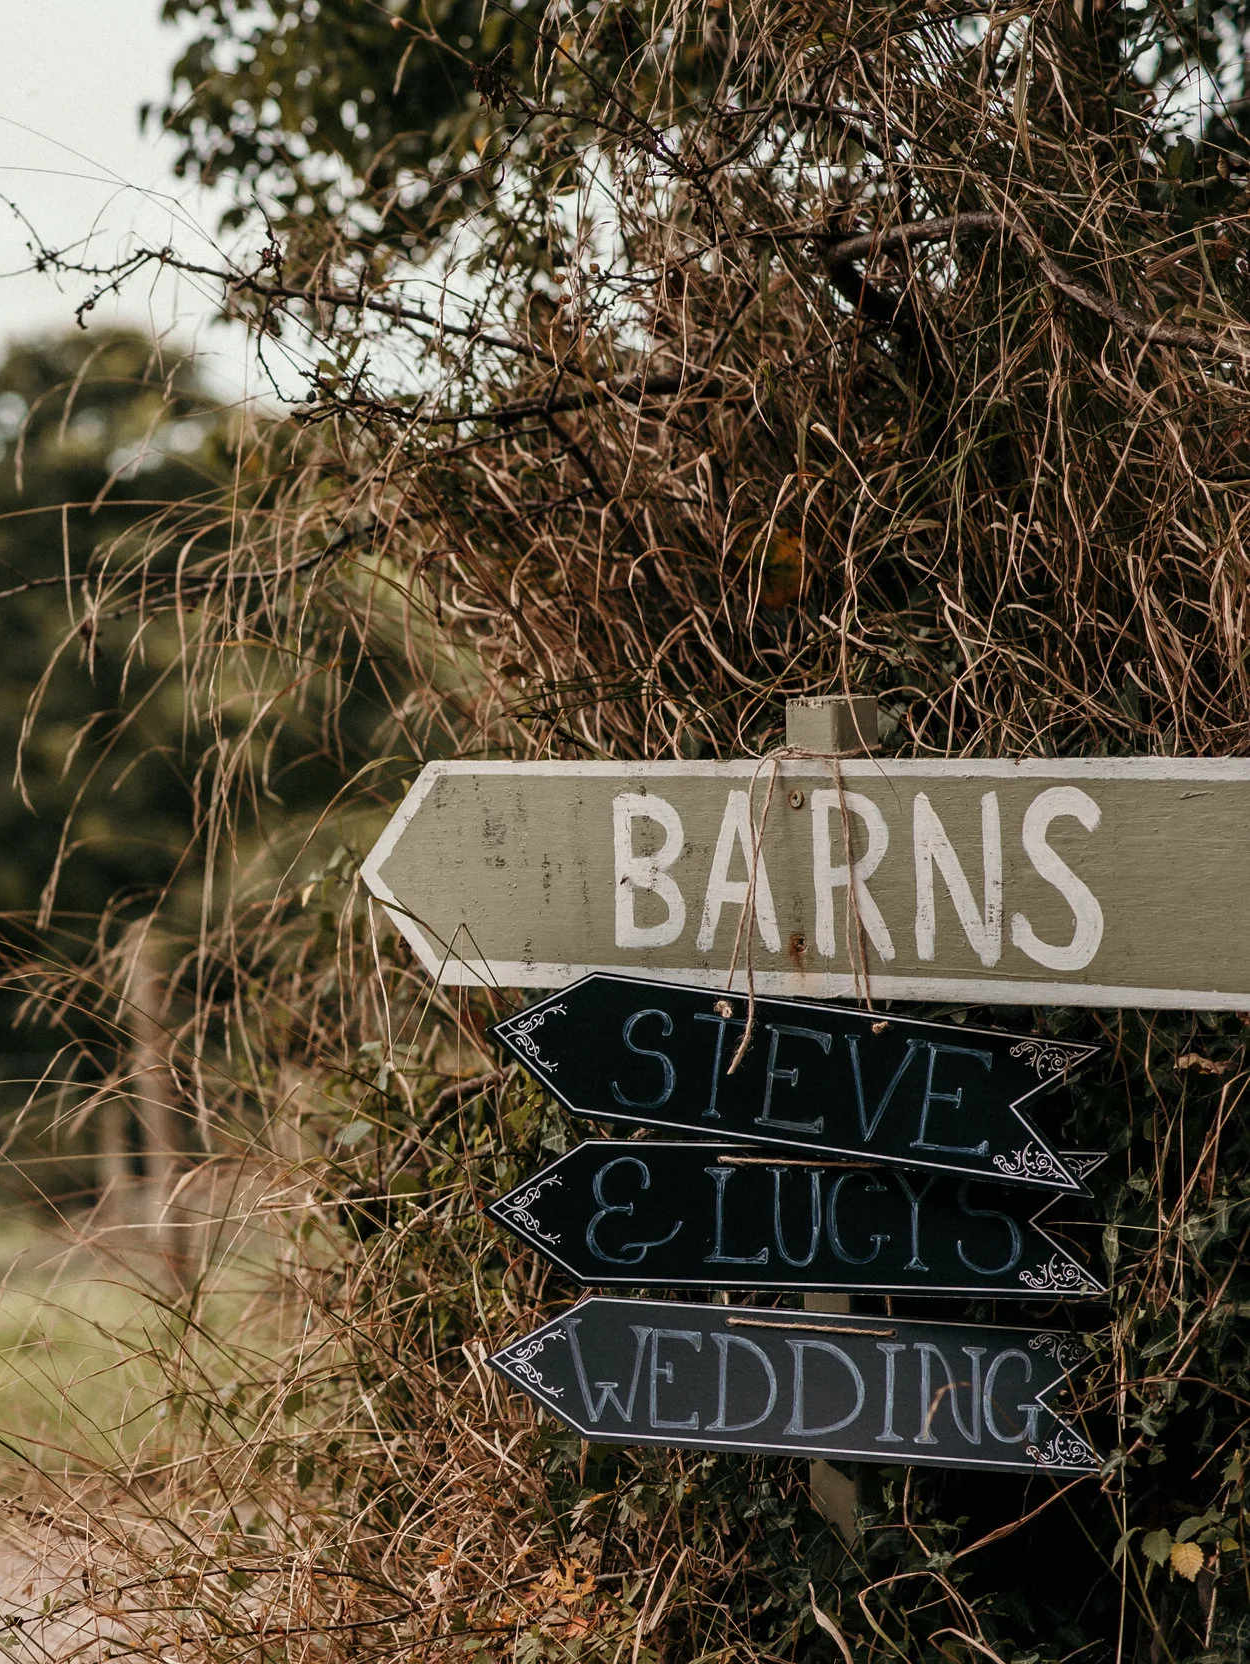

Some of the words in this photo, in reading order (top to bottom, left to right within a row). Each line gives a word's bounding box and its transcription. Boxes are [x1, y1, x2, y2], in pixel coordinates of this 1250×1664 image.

[612, 786, 1104, 971] BARNS
[610, 1009, 993, 1156] STEVE
[586, 1157, 683, 1264] &
[703, 1167, 1024, 1274] LUCYS
[561, 1317, 1044, 1445] WEDDING
